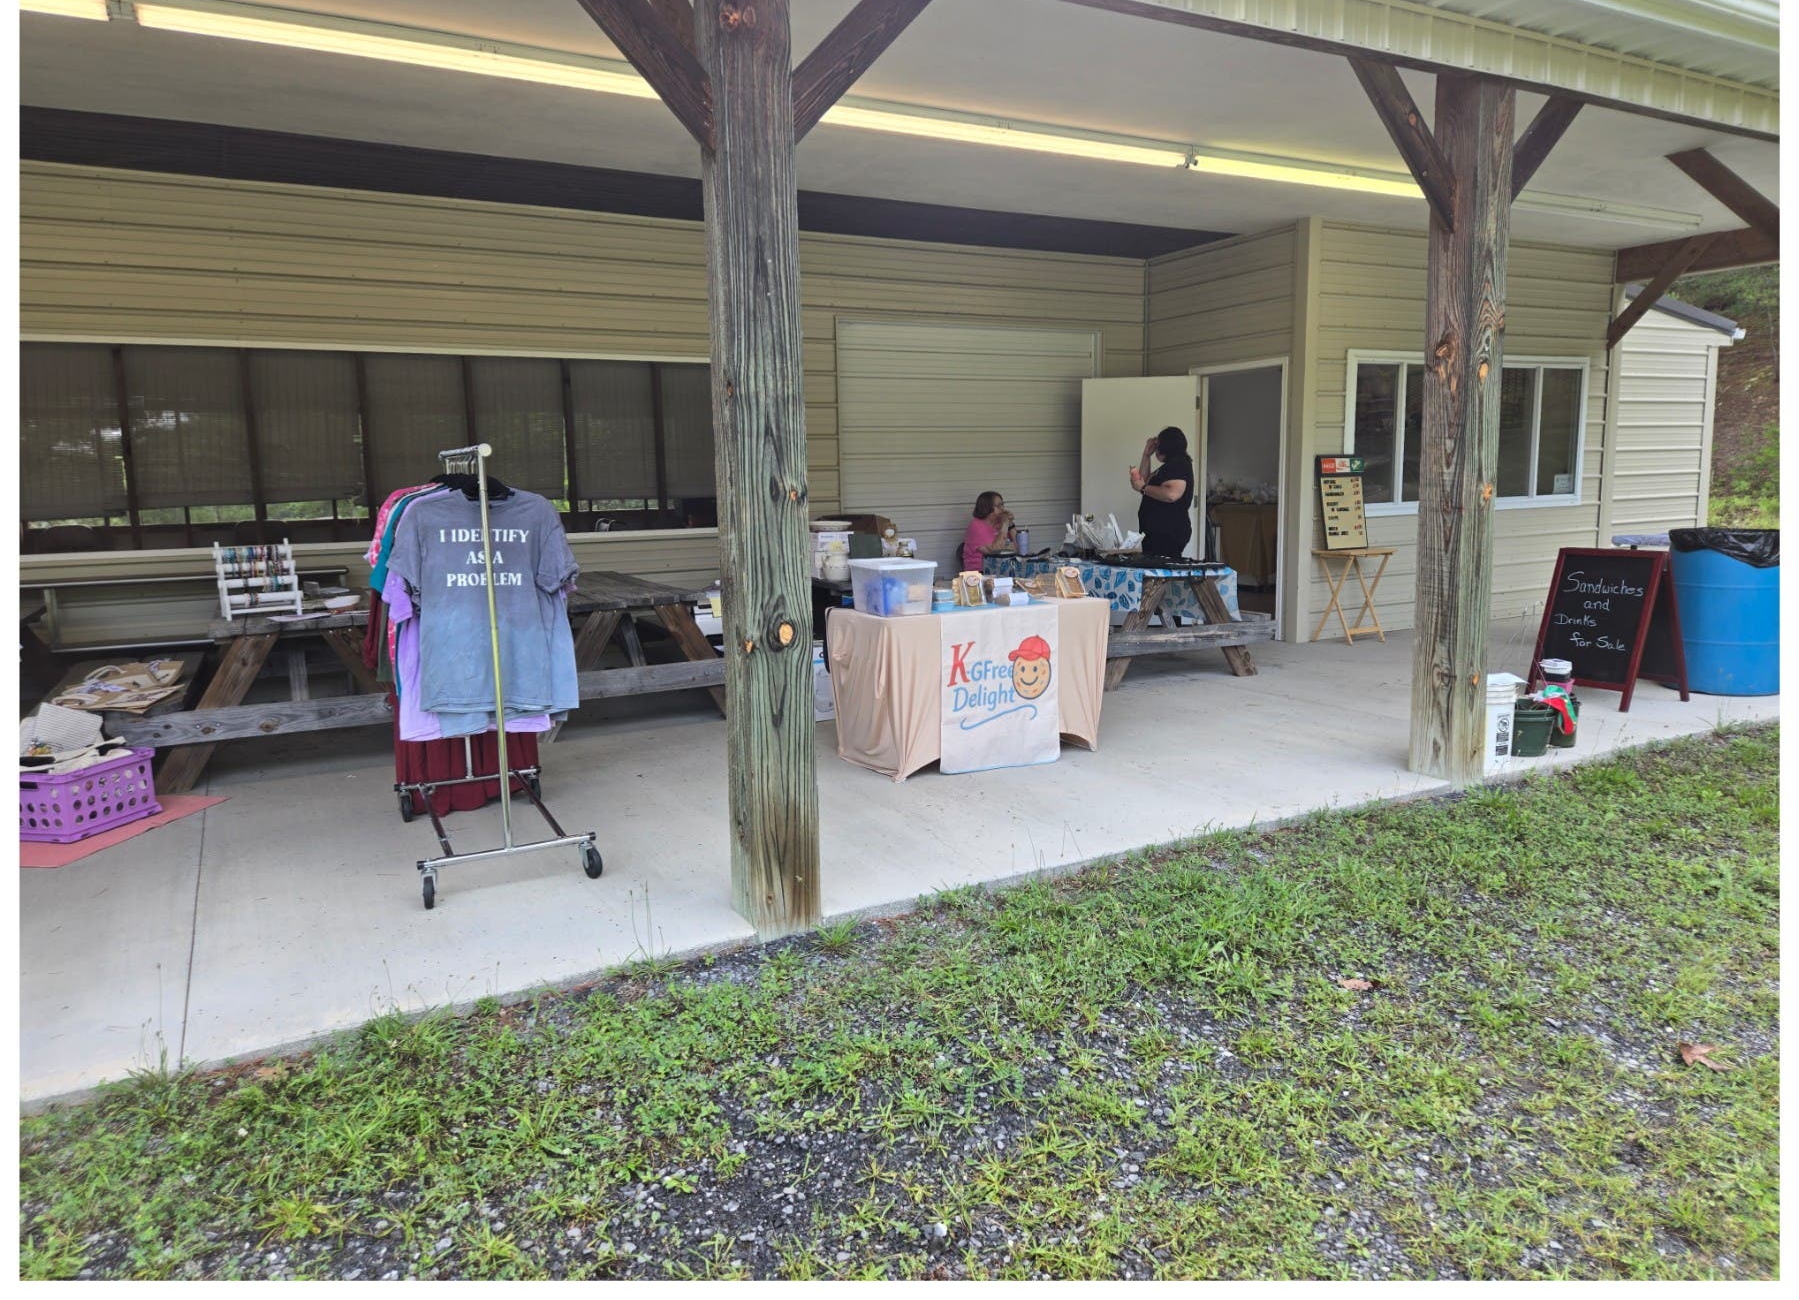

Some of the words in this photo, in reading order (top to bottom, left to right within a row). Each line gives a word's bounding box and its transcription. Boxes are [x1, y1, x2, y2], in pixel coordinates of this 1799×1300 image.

[440, 529, 445, 542] I
[451, 529, 529, 543] IDETIFY
[466, 551, 486, 564] AS
[492, 551, 504, 564] A
[1562, 571, 1644, 597] Sandwiches
[1584, 599, 1610, 611] and
[1569, 631, 1592, 647] for
[1596, 636, 1626, 651] Sale
[952, 682, 1016, 712] Delight
